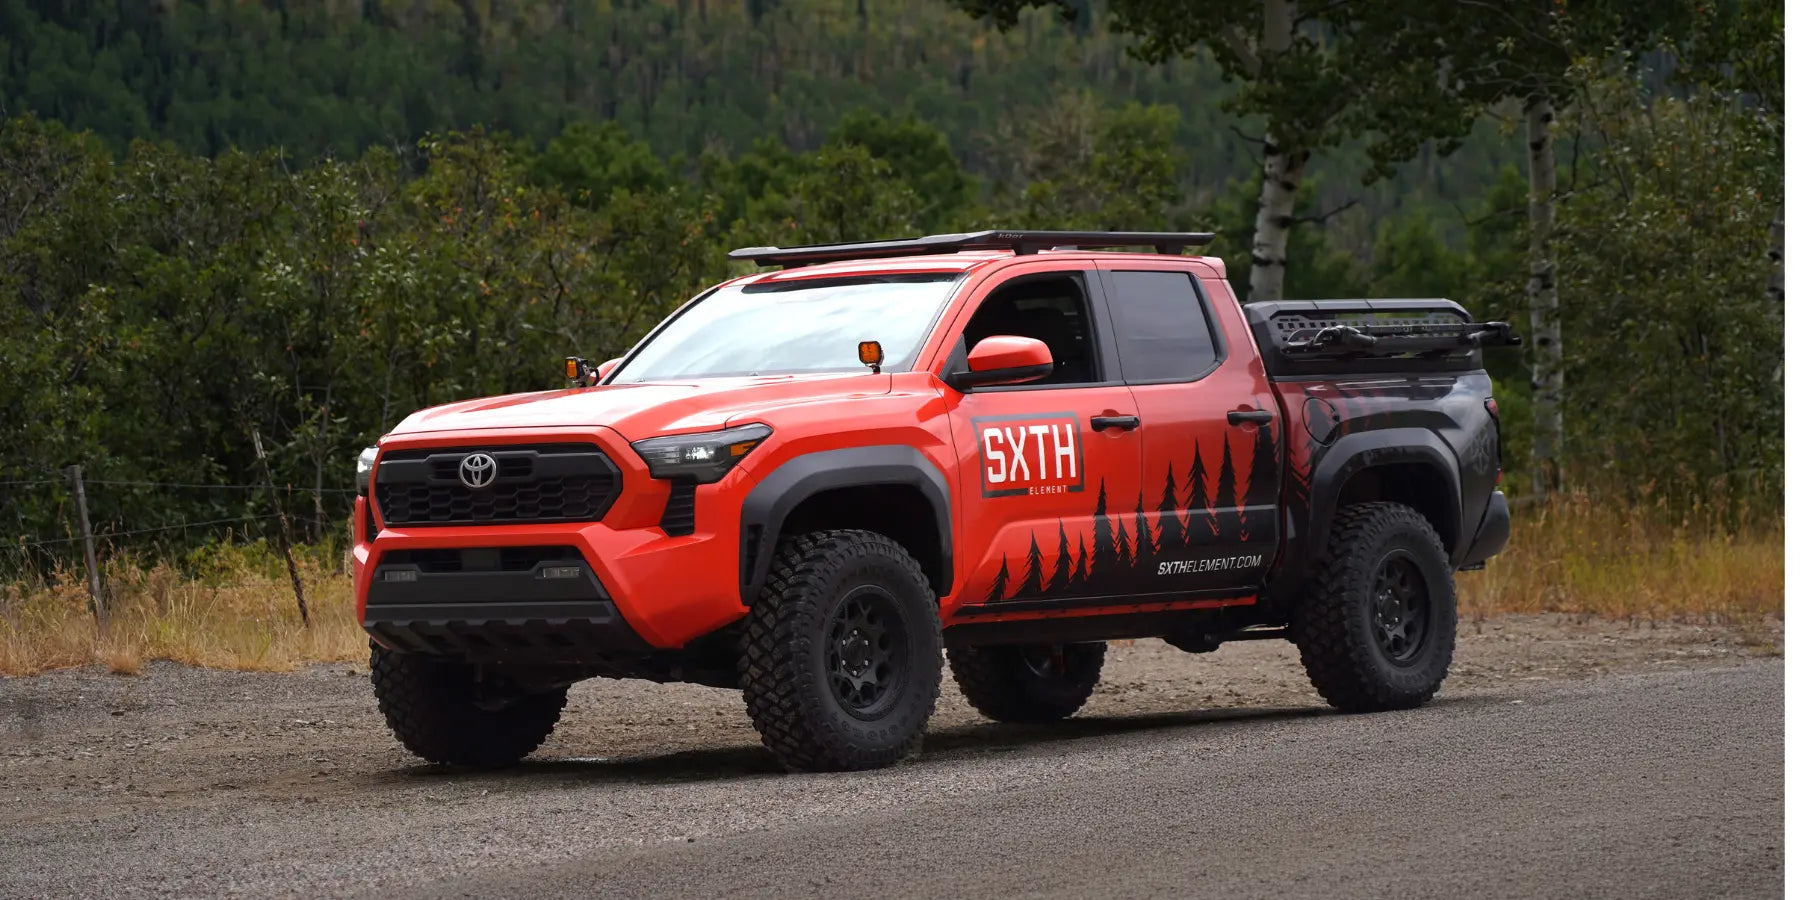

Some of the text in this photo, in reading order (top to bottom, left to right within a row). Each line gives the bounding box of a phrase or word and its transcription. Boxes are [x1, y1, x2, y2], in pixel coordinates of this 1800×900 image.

[983, 423, 1076, 483] SXTH
[1029, 485, 1067, 495] ELEMENT
[1157, 554, 1262, 575] SXTHELEMENT.COM
